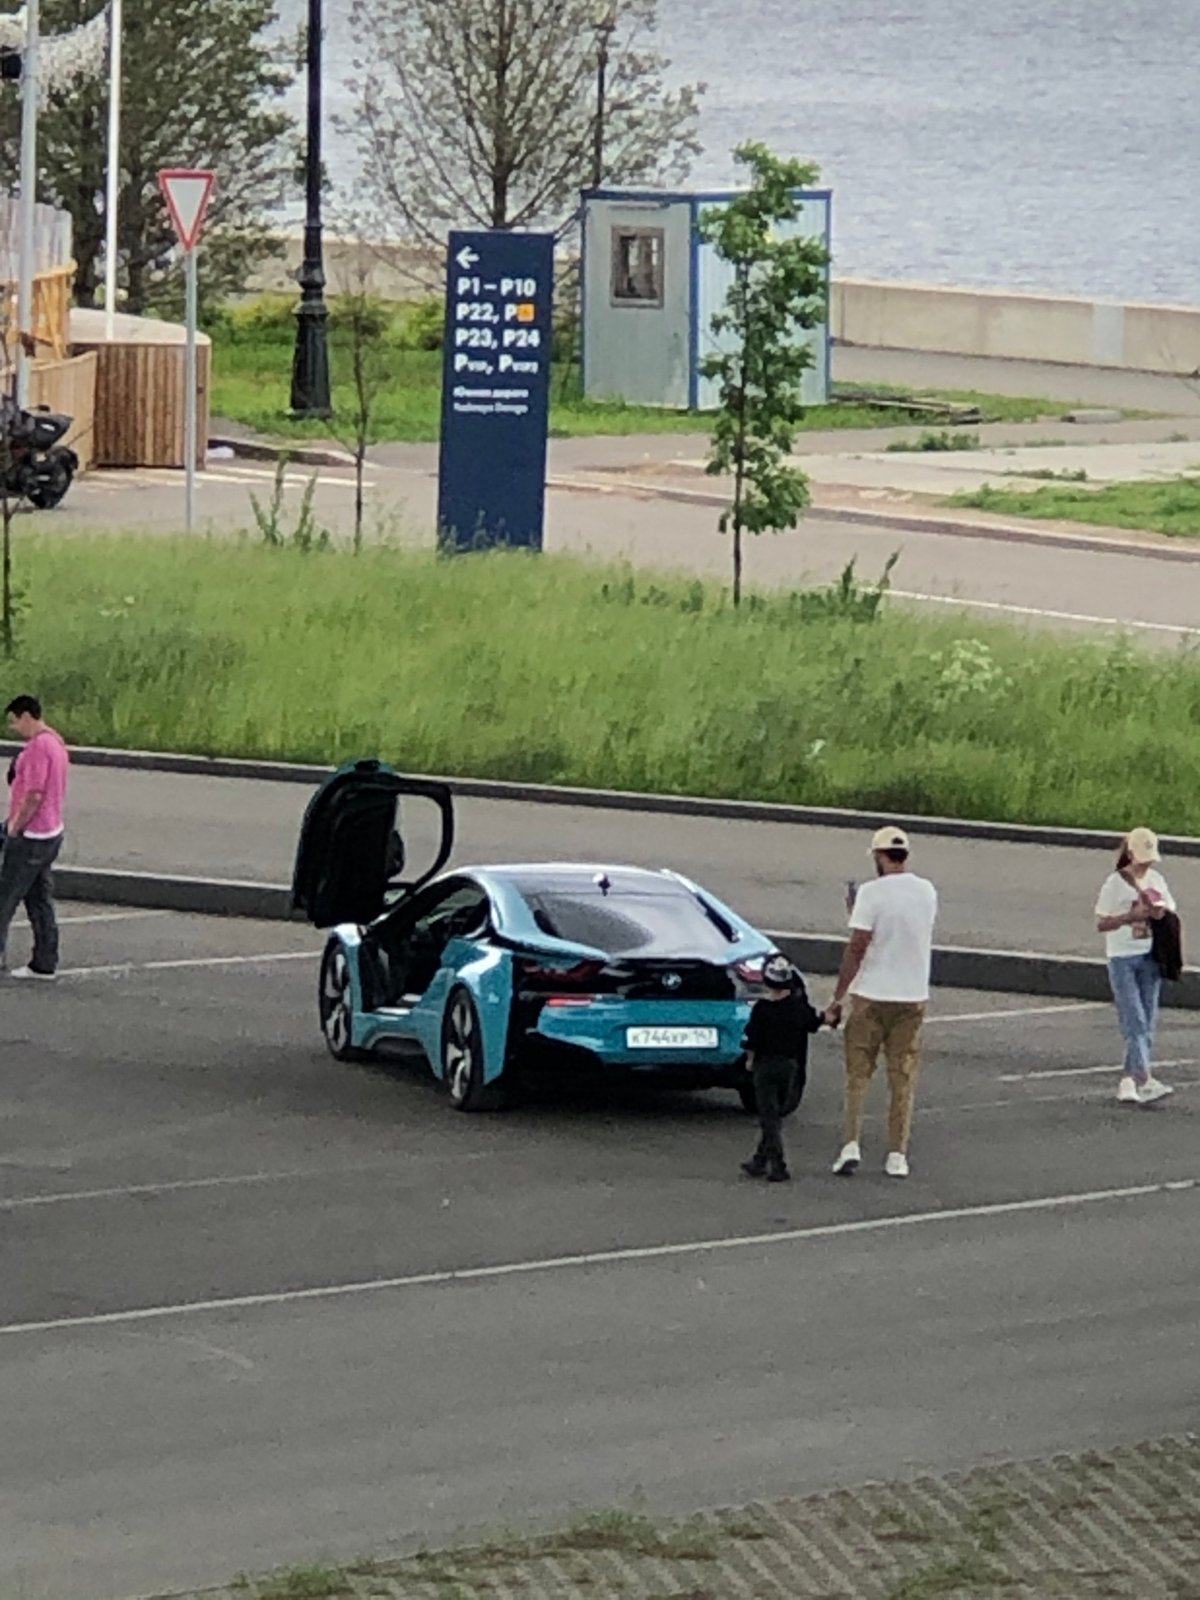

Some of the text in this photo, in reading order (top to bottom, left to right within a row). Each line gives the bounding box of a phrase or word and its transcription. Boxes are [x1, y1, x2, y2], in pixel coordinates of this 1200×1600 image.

[456, 302, 500, 325] P22,
[455, 327, 540, 350] P23, P24
